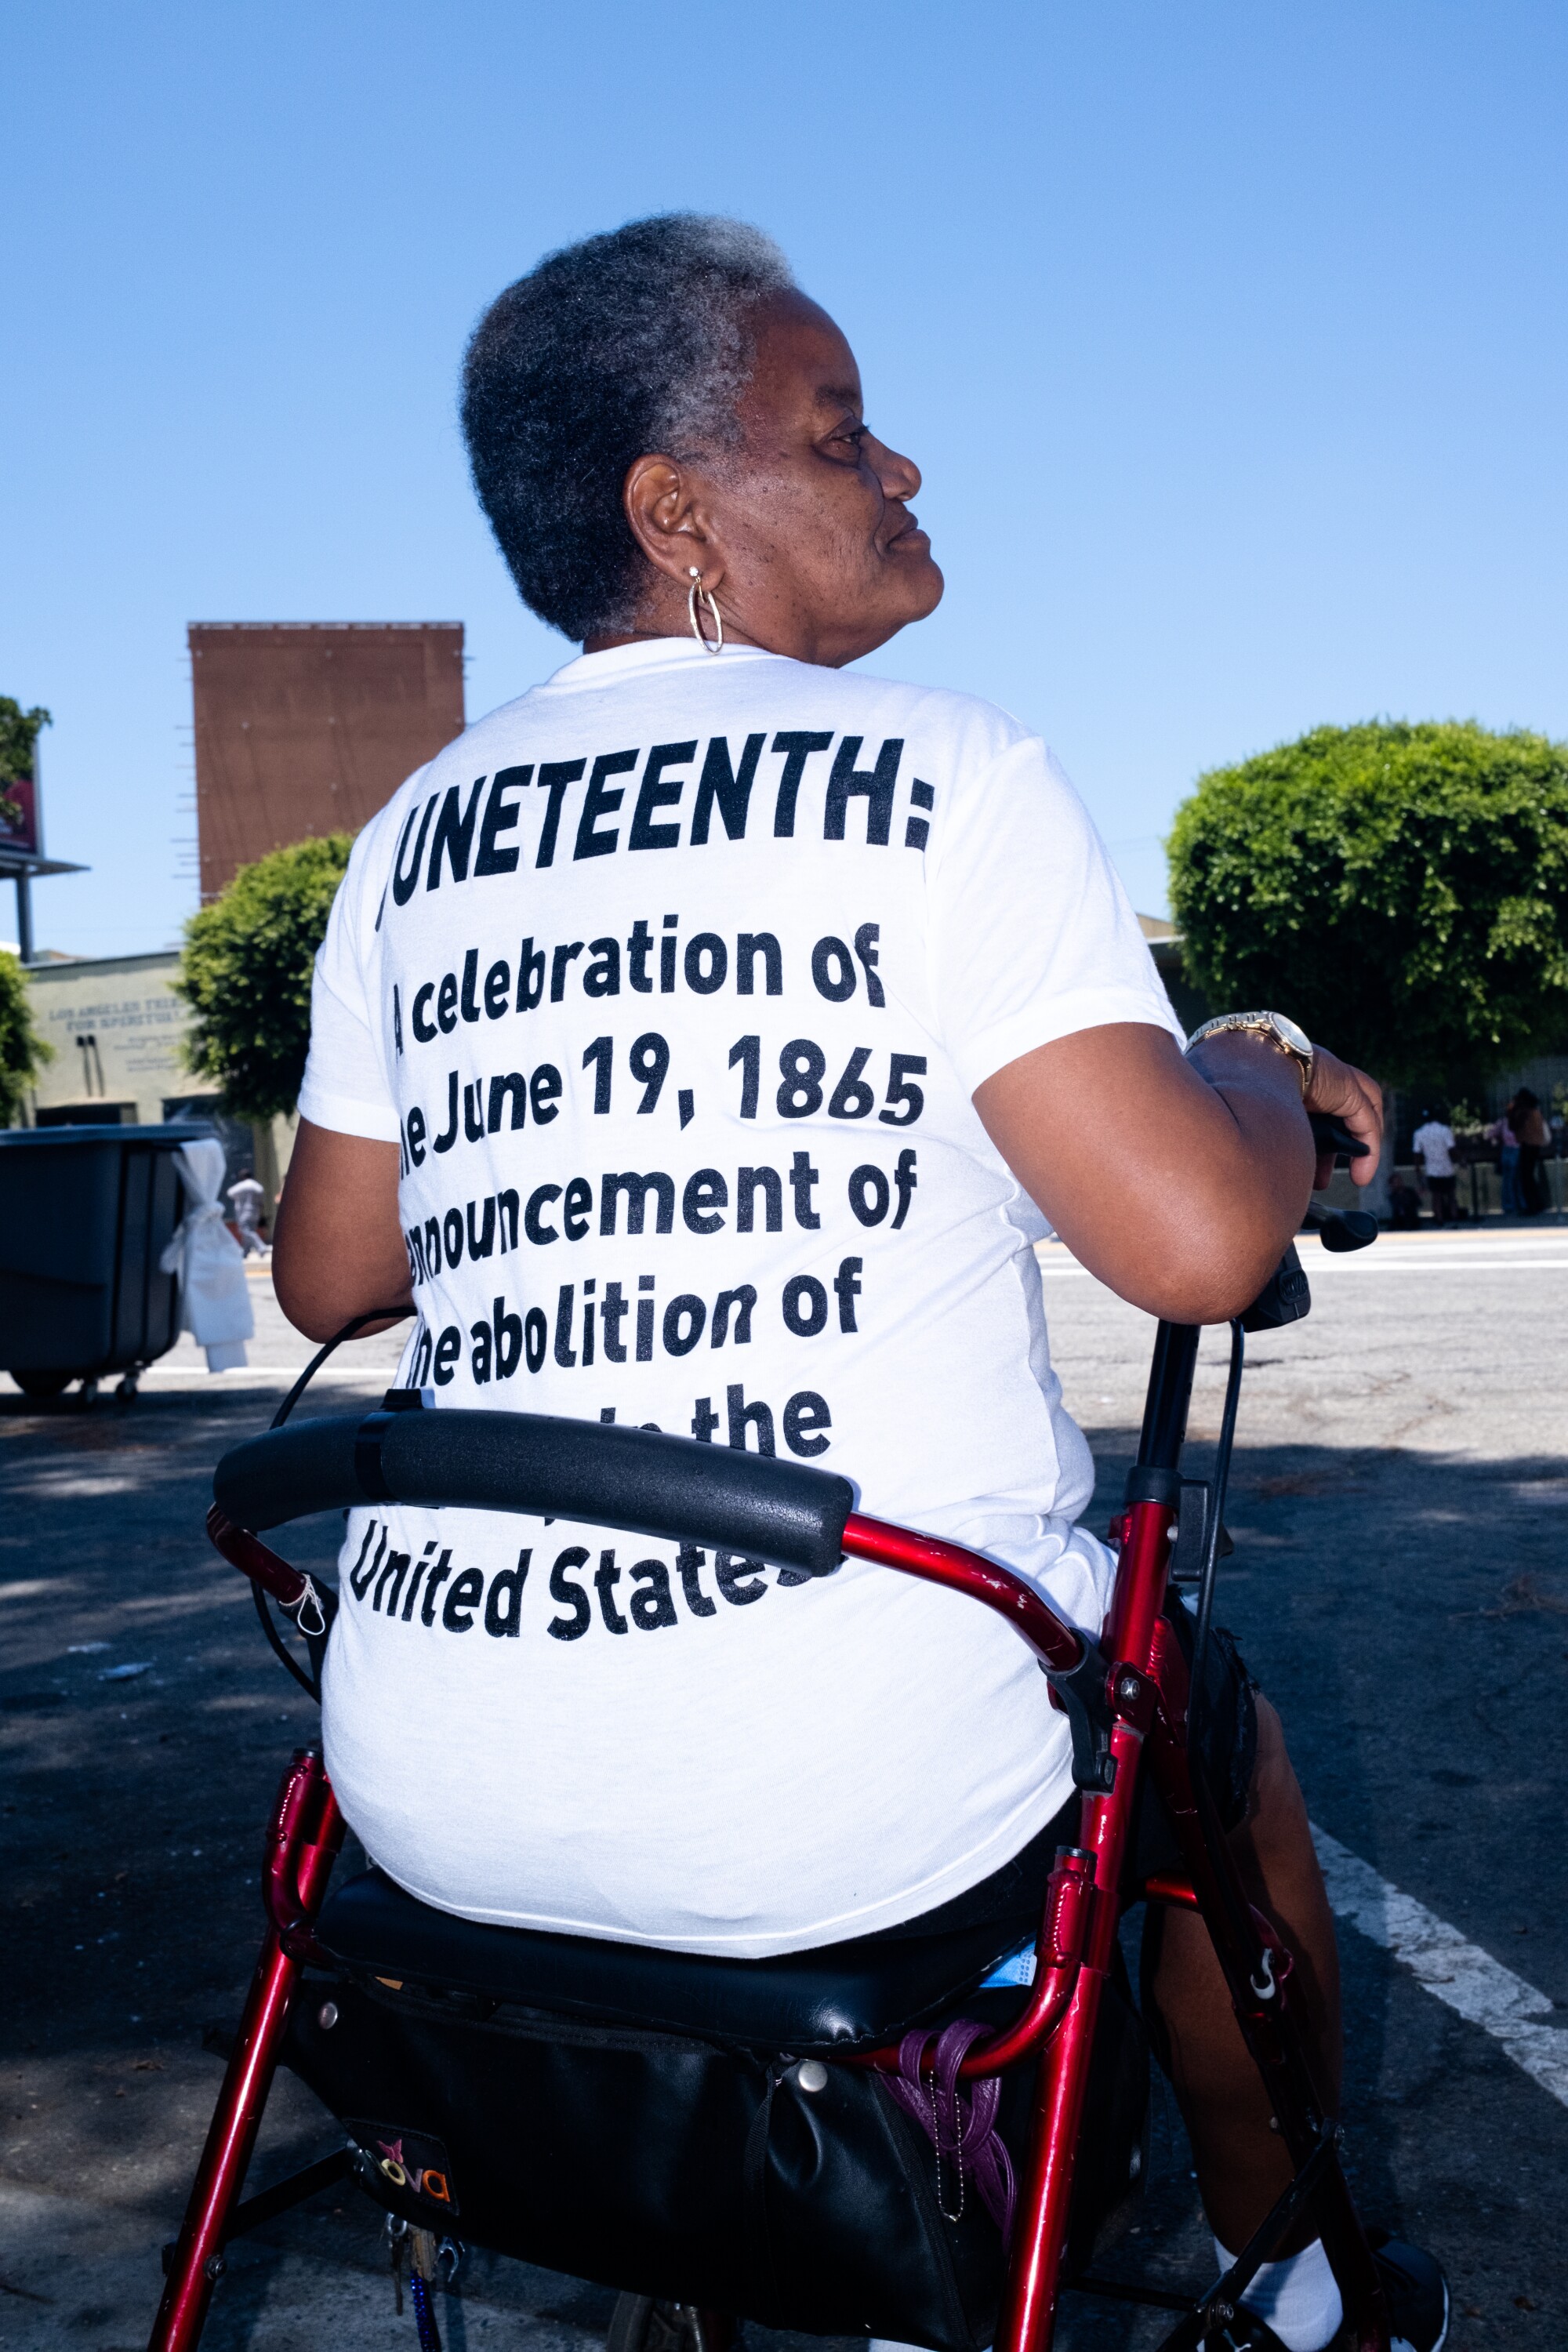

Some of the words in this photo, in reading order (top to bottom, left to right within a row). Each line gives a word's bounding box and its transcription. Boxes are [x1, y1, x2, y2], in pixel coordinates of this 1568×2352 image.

[375, 731, 935, 932] UNETEENTH:
[412, 914, 783, 1044] celebration
[811, 922, 886, 1008] of
[433, 1062, 563, 1154] June
[582, 1033, 695, 1131] 19,
[728, 1035, 927, 1127] 1865
[848, 1149, 917, 1229] of
[470, 1275, 757, 1385] abolition
[782, 1256, 863, 1338] of
[691, 1383, 833, 1457] the
[349, 1519, 533, 1639] United
